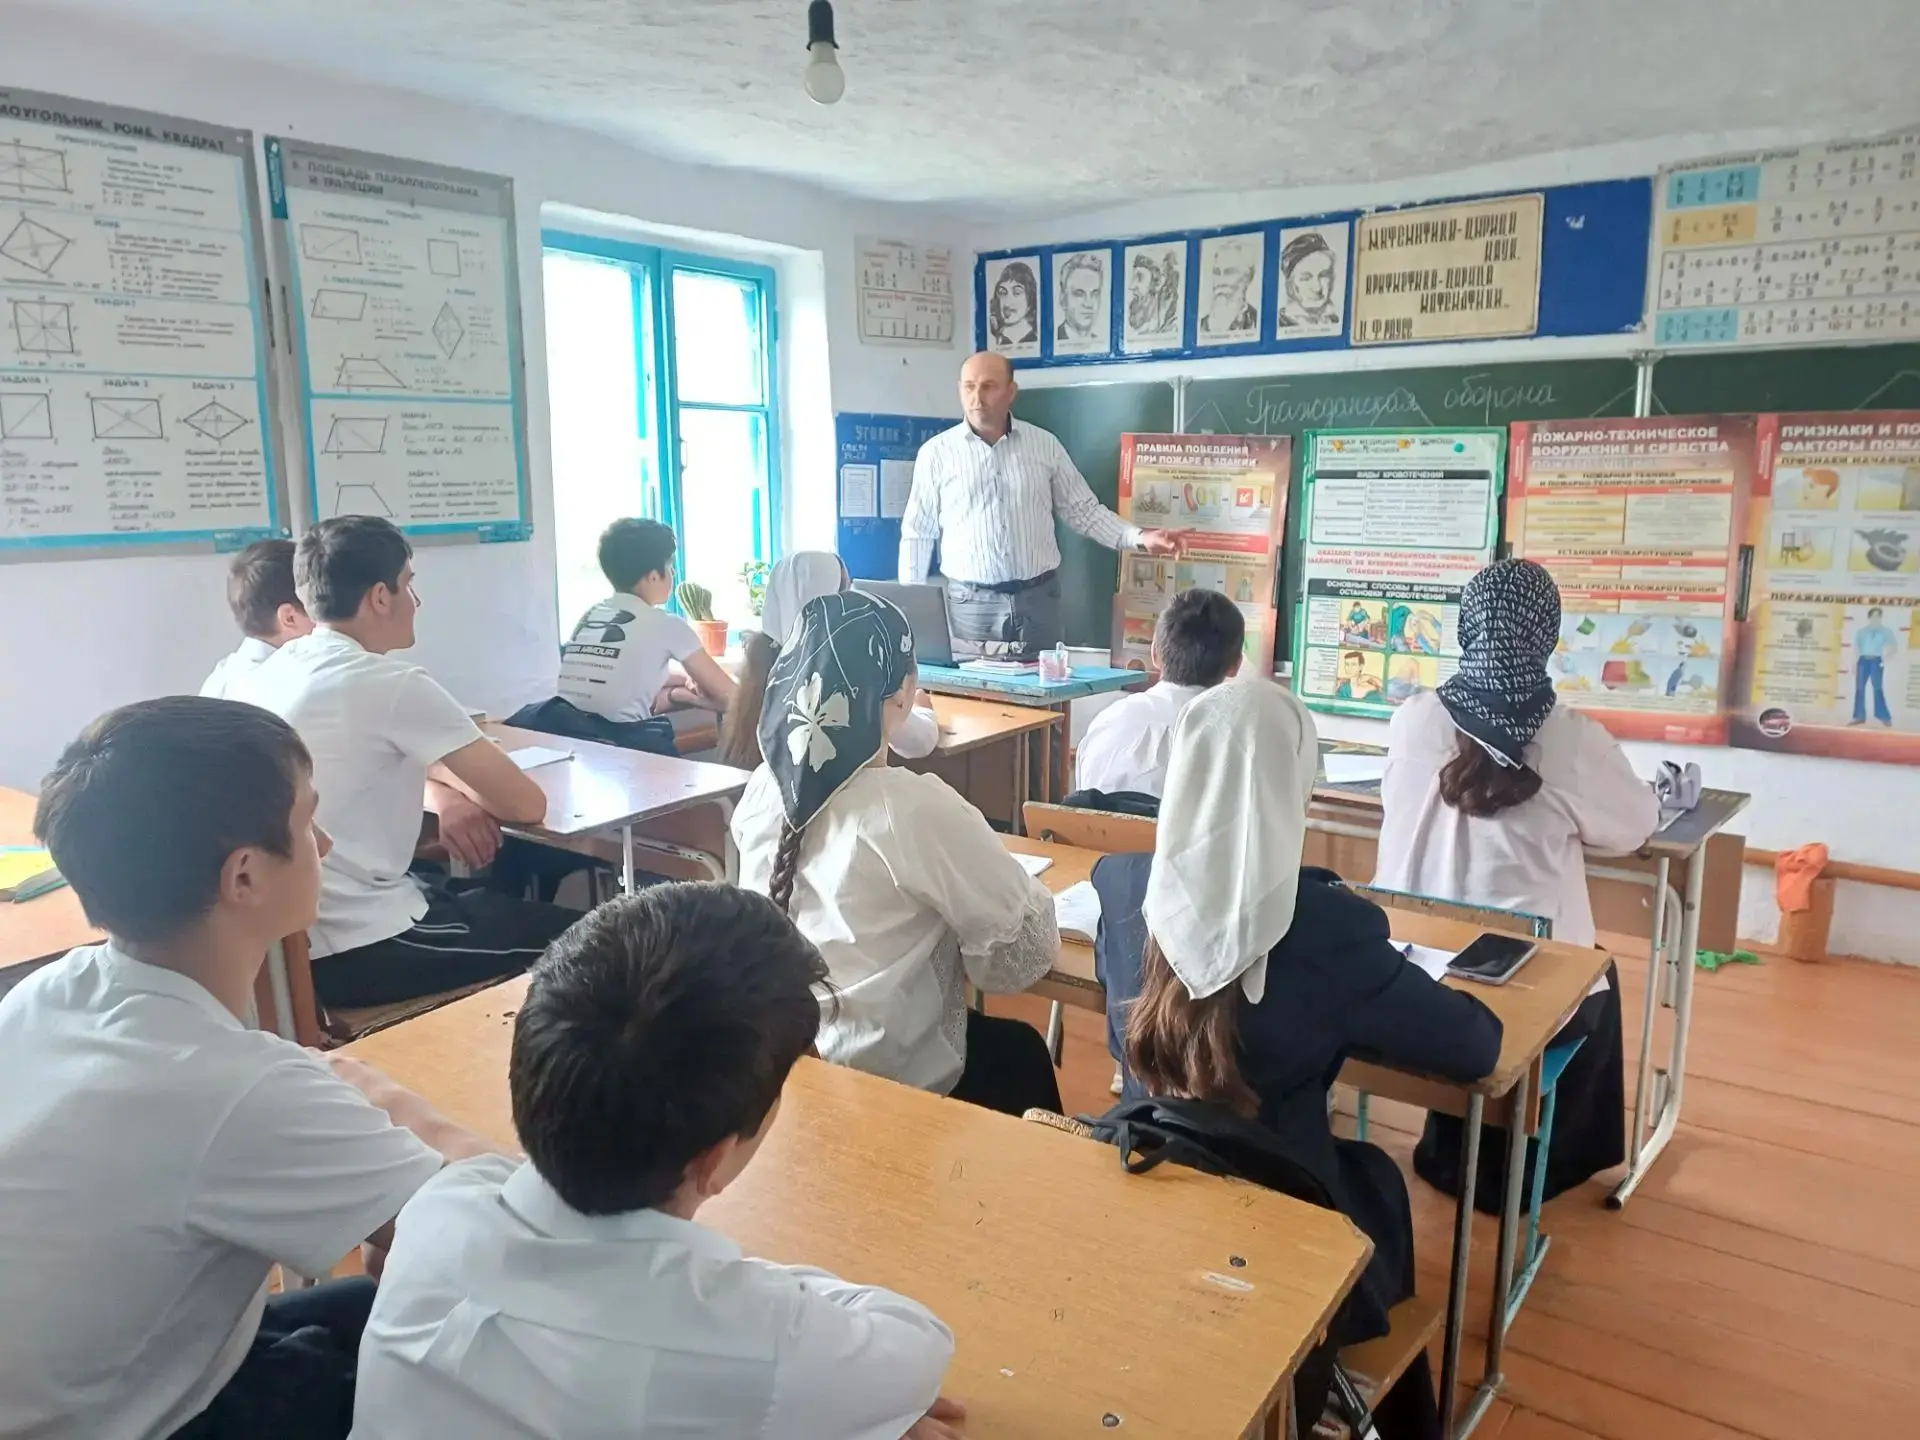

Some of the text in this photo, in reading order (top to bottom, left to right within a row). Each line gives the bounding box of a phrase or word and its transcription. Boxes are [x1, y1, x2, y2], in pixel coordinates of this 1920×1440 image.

[163, 130, 224, 152] КВАДРАТ
[308, 160, 371, 182] ПЛОЩАДЬ
[309, 176, 384, 195] И ТРАПЕЦИИ
[1444, 373, 1555, 425] оборона
[1532, 426, 1718, 444] ПОЖАРНО-ТЕХНИЧЕСКОЕ
[1782, 423, 1874, 437] ПРИЗНАКИ
[1878, 423, 1891, 436] И
[1136, 443, 1249, 456] ПРАВИЛА ПОВЕДЕНИЯ
[1532, 440, 1729, 457] ВООРУЖЕНИЕ И СРЕДСТВА
[1780, 439, 1865, 452] ФАКТОРЫ
[1136, 454, 1157, 464] ПРИ
[1159, 455, 1201, 465] ПОЖАРЕ
[1781, 455, 1848, 465] ПРИЗНАКИ
[1356, 471, 1380, 479] ВИДЫ
[1660, 478, 1723, 486] ВООРУЖЕНИЕ
[1327, 580, 1461, 594] ОСНОВНЫЕ СПОСОБЫ ВРЕМЕННОЙ
[1339, 588, 1383, 598] ОСТАНОВКИ
[1633, 585, 1718, 593] ПОЖАРОТУШЕНИЯ
[1770, 592, 1864, 605] ПОРАЖАЮЩИЕ
